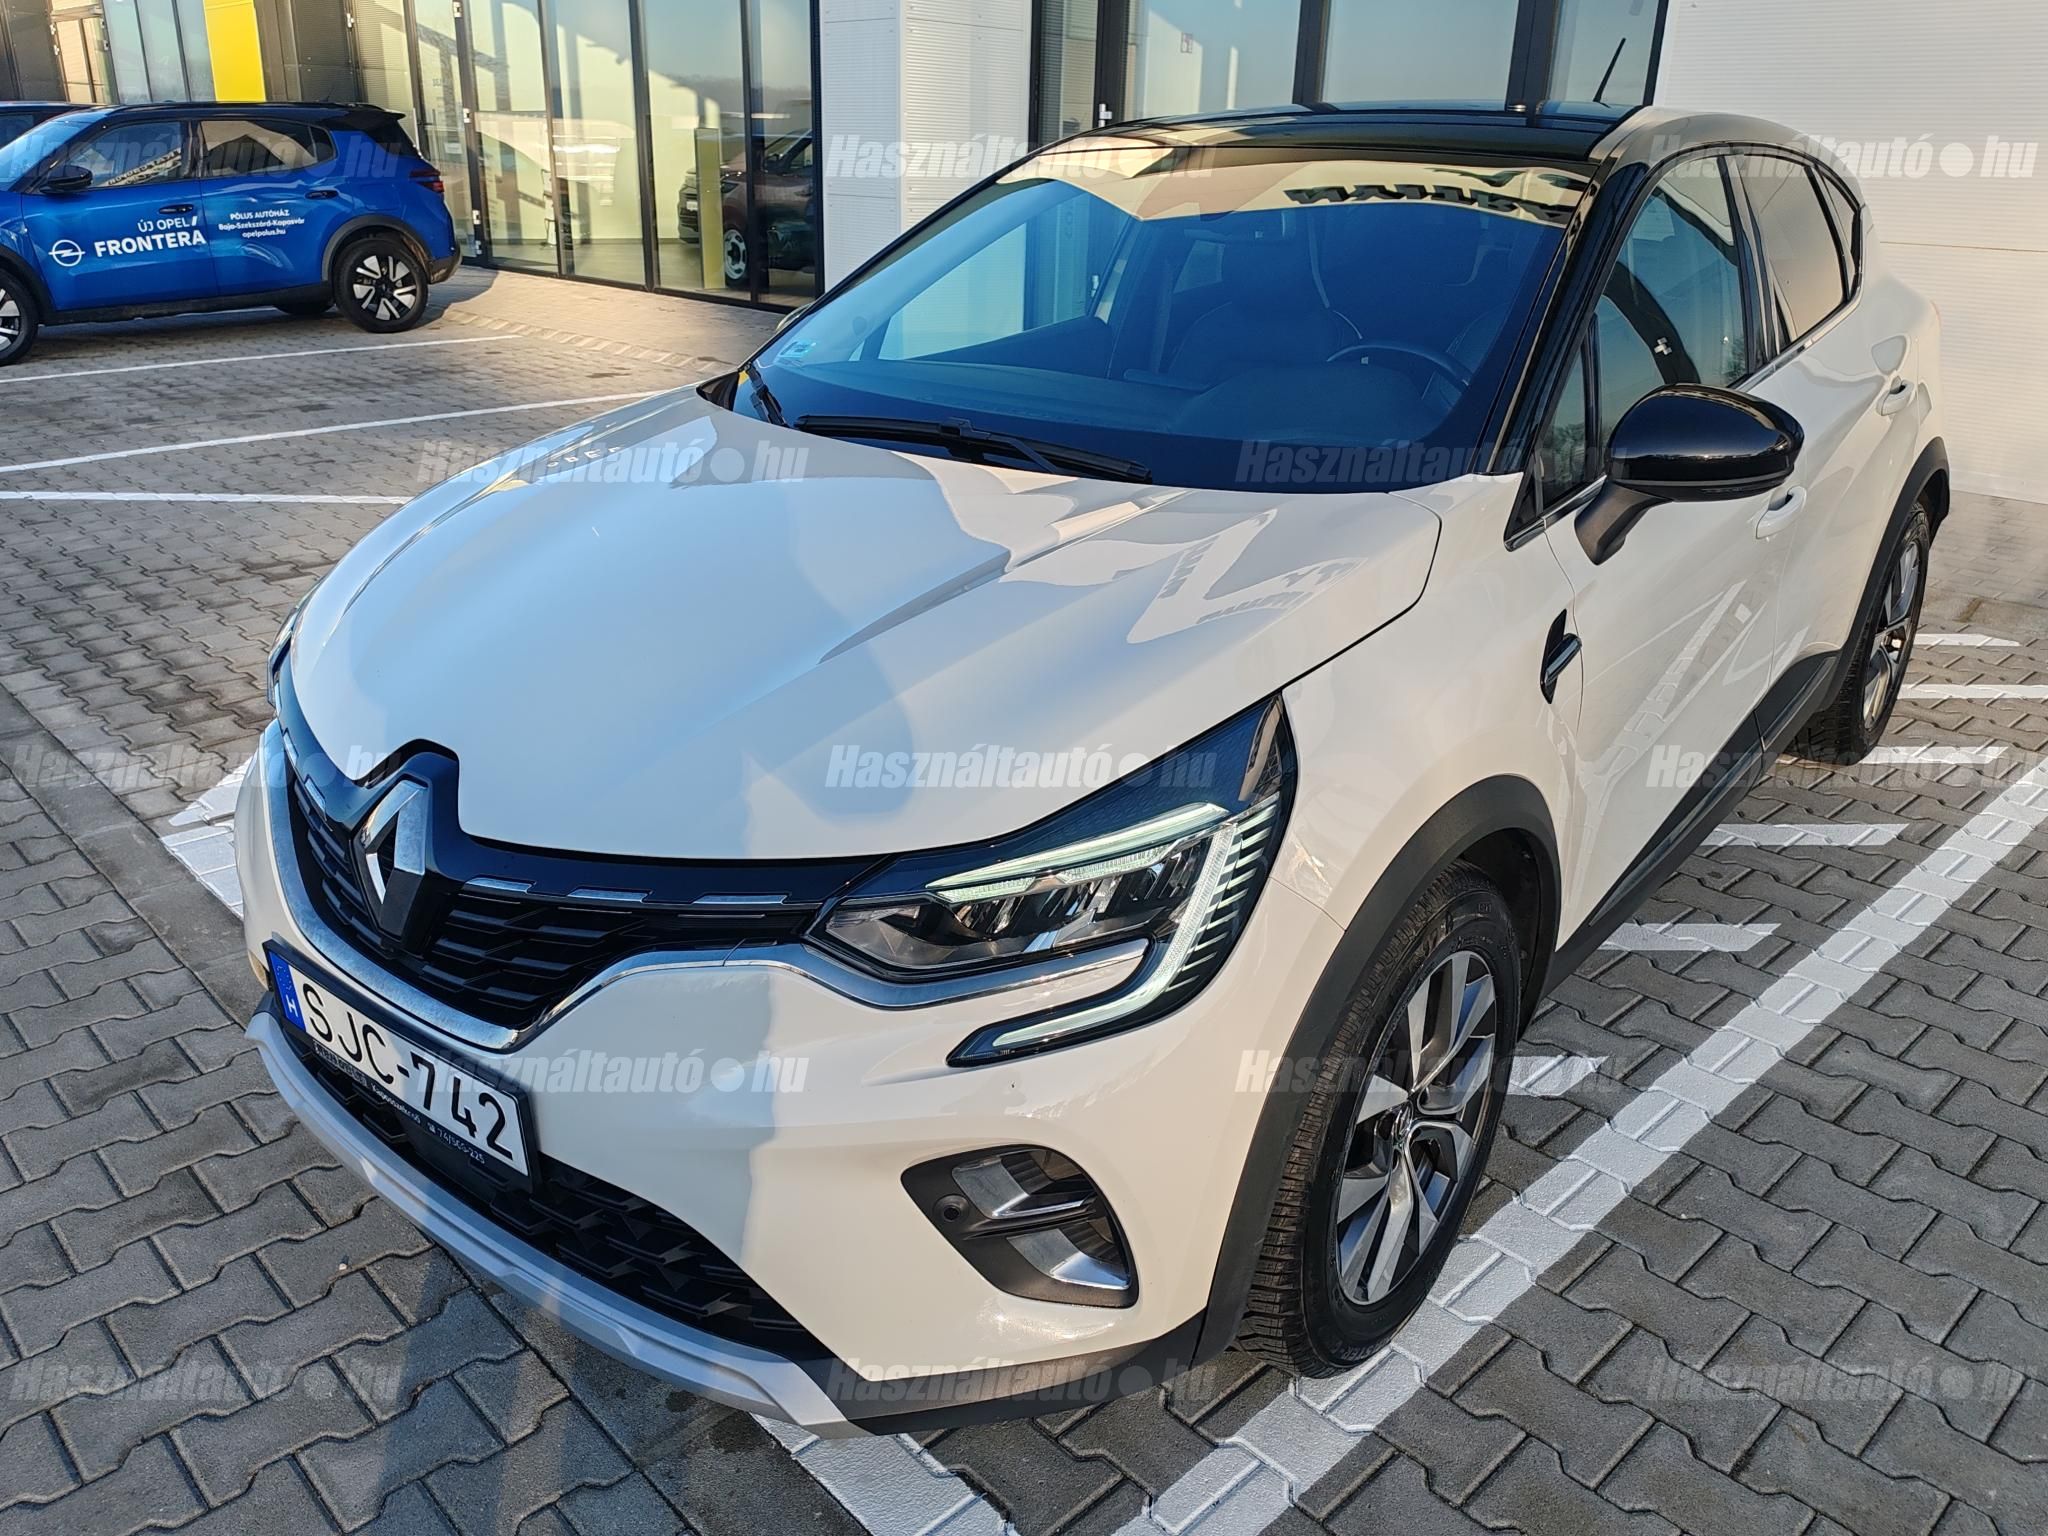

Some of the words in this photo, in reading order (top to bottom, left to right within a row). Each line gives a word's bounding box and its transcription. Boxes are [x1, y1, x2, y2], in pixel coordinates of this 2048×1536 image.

[230, 211, 253, 221] PÓLUS
[254, 208, 290, 219] AUTÓHÁZ
[137, 219, 154, 233] ÚJ
[156, 218, 190, 231] OPEL
[242, 228, 287, 239] opelpolus.hu
[94, 229, 207, 258] FRONTERA
[286, 995, 299, 1018] H
[302, 983, 513, 1161] SJC-742
